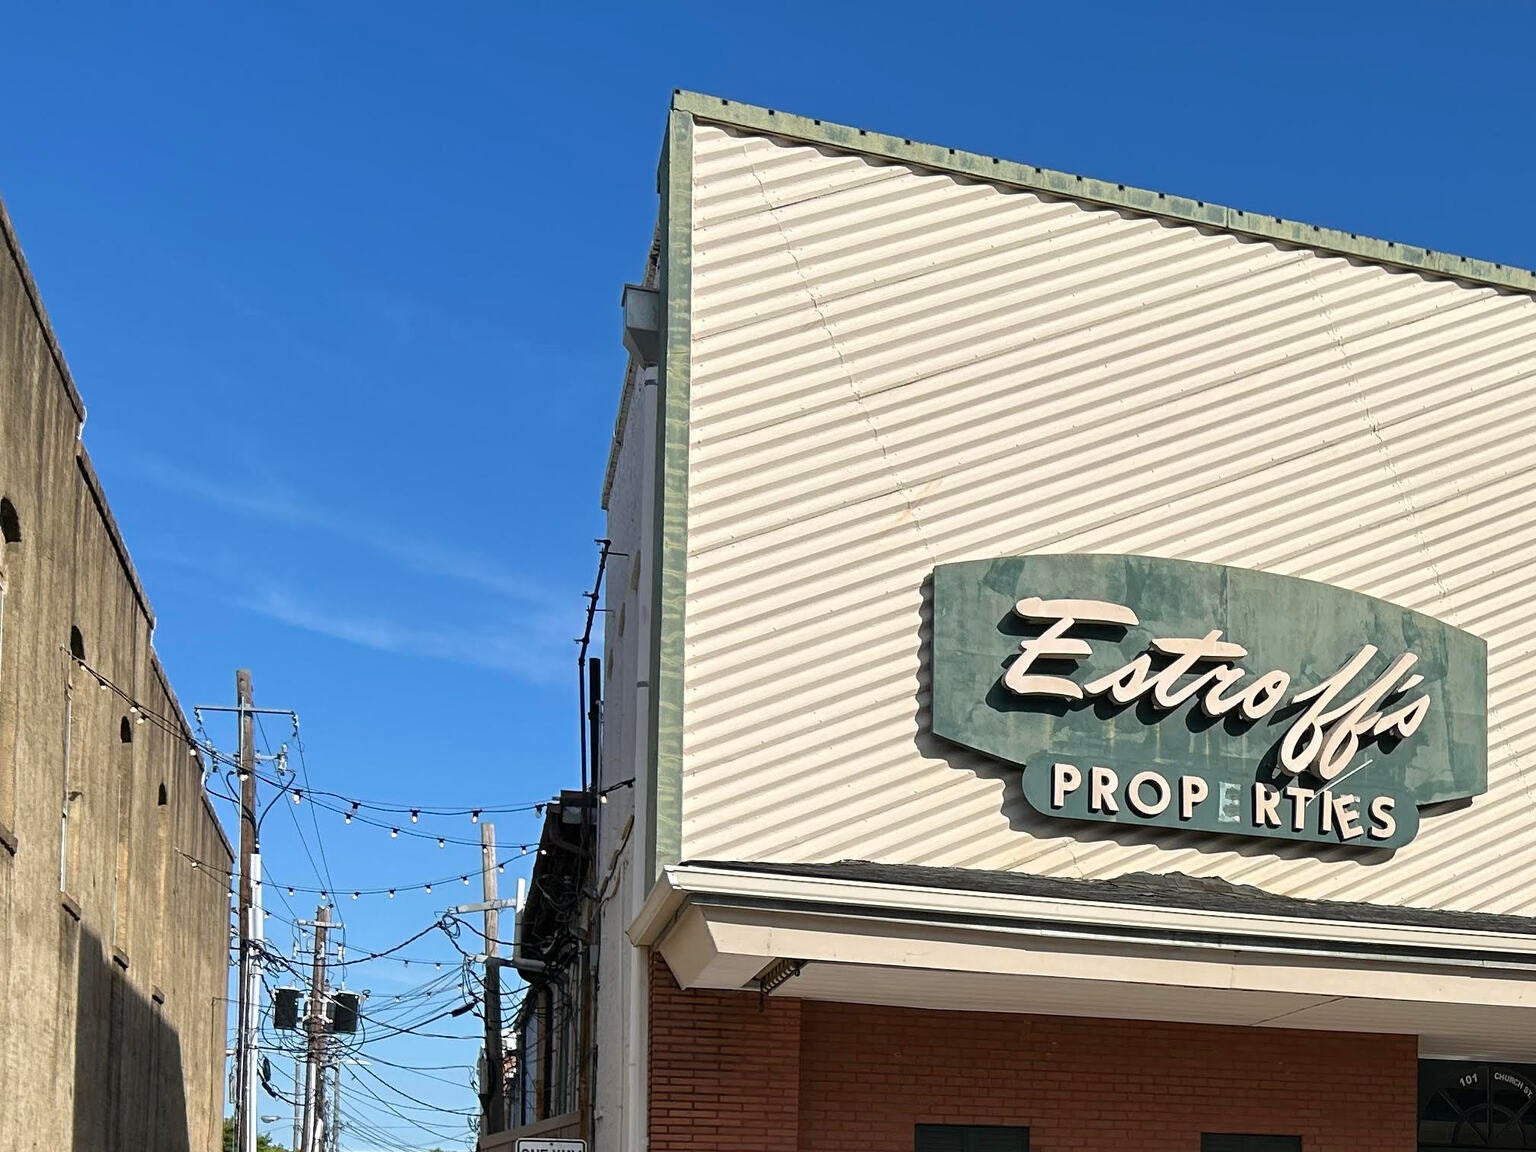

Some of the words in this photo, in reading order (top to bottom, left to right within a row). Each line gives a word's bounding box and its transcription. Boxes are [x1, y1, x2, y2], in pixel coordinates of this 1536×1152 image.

[1003, 597, 1432, 780] Estroff's
[1052, 762, 1398, 843] PROPERTIES
[1459, 1073, 1478, 1088] 101
[1494, 1072, 1523, 1089] CHURCH
